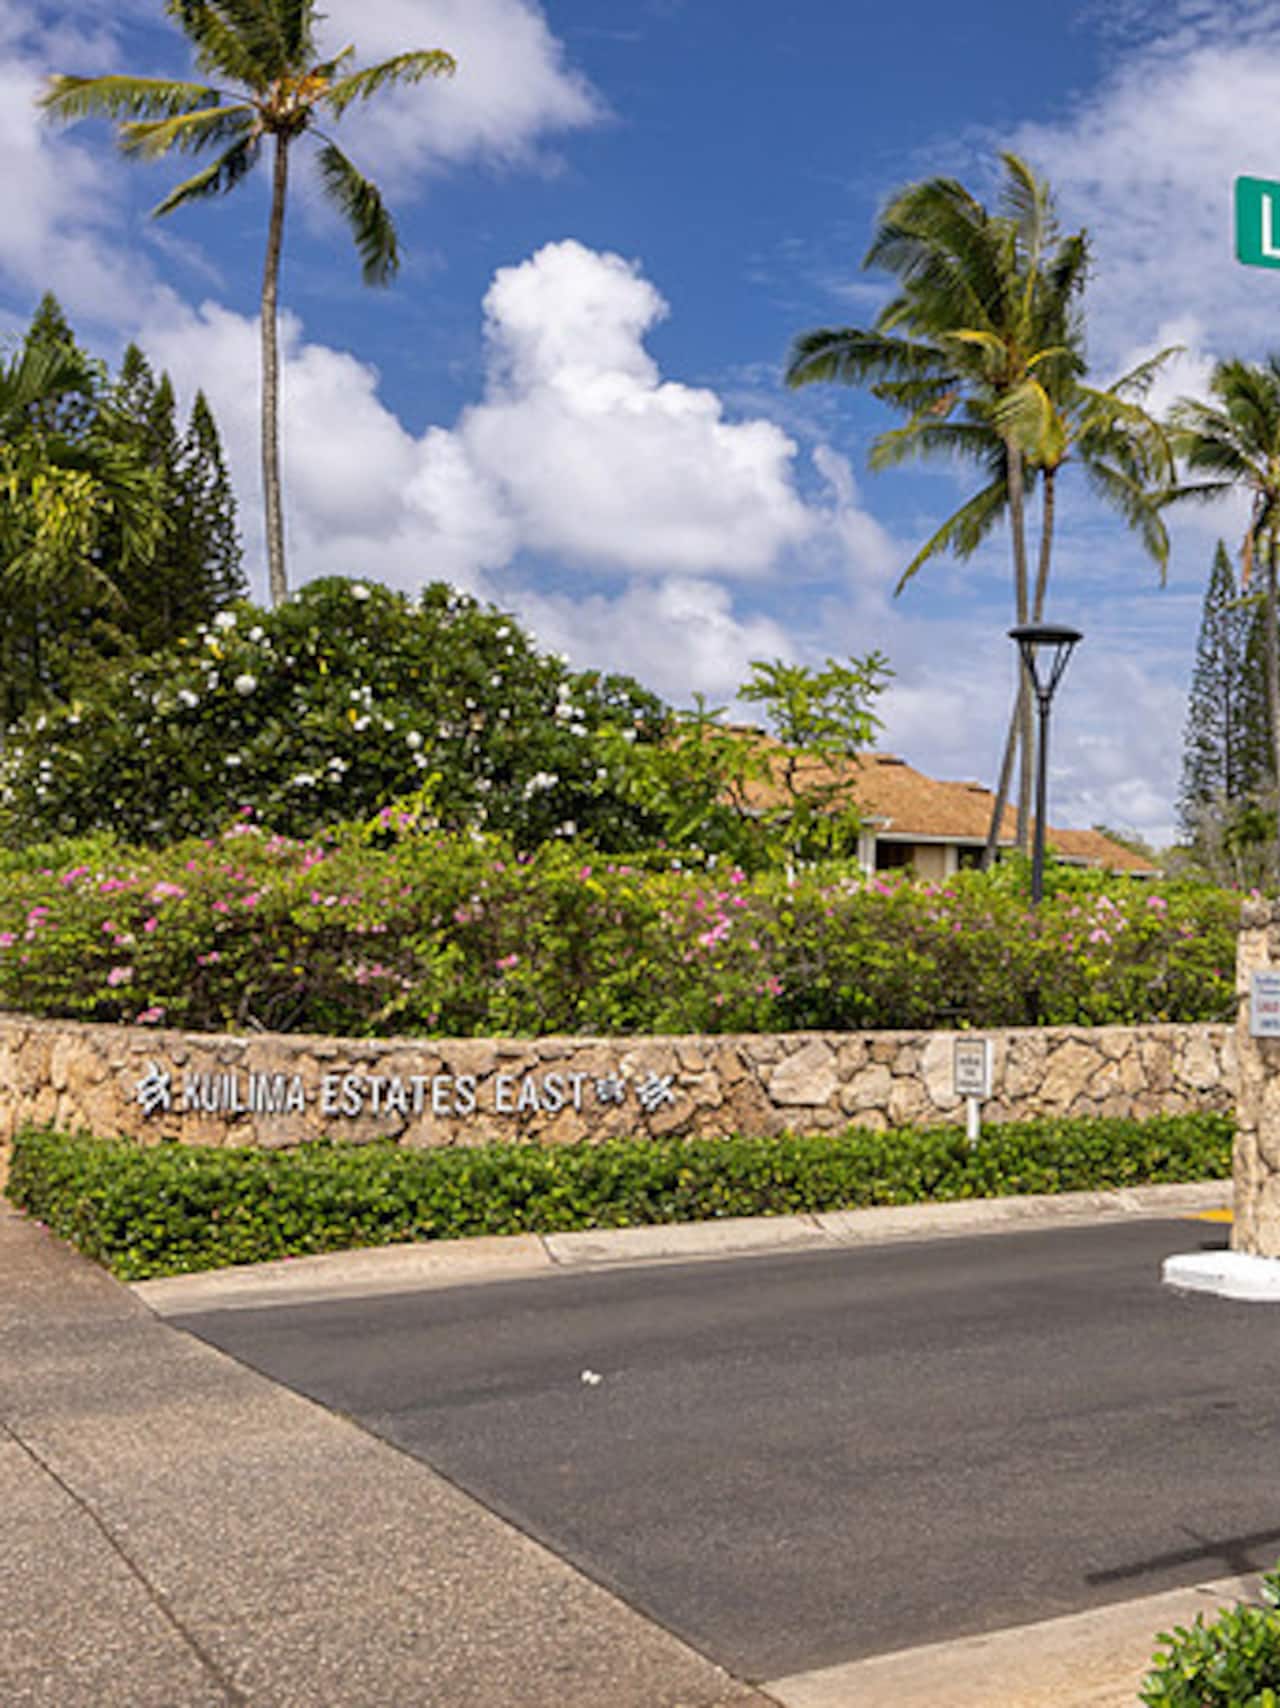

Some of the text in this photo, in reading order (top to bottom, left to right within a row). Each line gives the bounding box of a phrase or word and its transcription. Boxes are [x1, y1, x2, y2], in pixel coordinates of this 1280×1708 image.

[181, 1070, 589, 1117] KUILIMA ESTATES EAST
